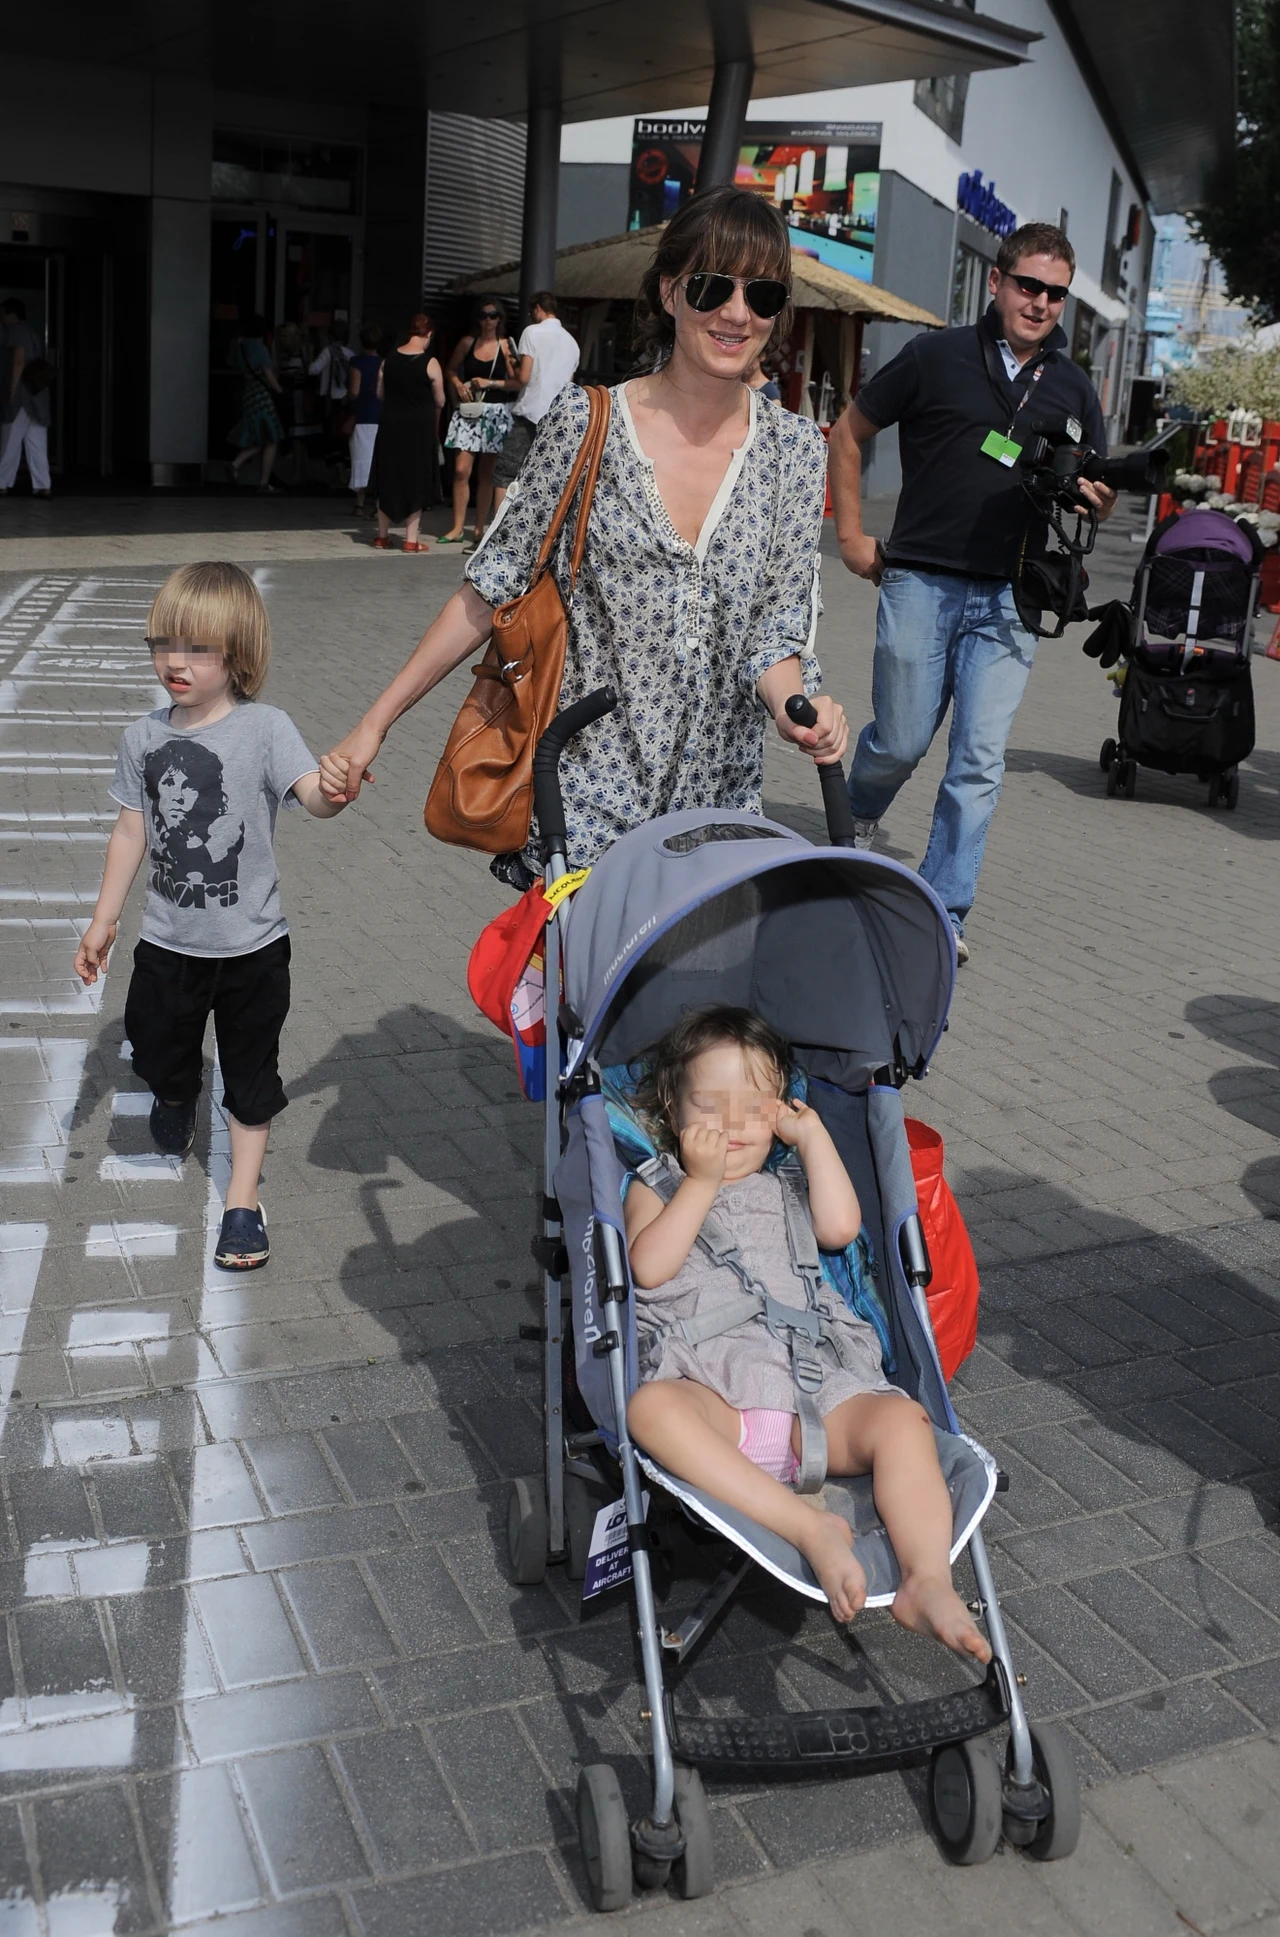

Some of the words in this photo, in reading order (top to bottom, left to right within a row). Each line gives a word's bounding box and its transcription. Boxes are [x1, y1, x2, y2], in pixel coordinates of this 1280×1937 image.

[582, 1215, 602, 1343] maclaren
[595, 1546, 629, 1568] DELIVER
[608, 1561, 619, 1572] AT
[592, 1566, 632, 1590] AIRCRAFT
